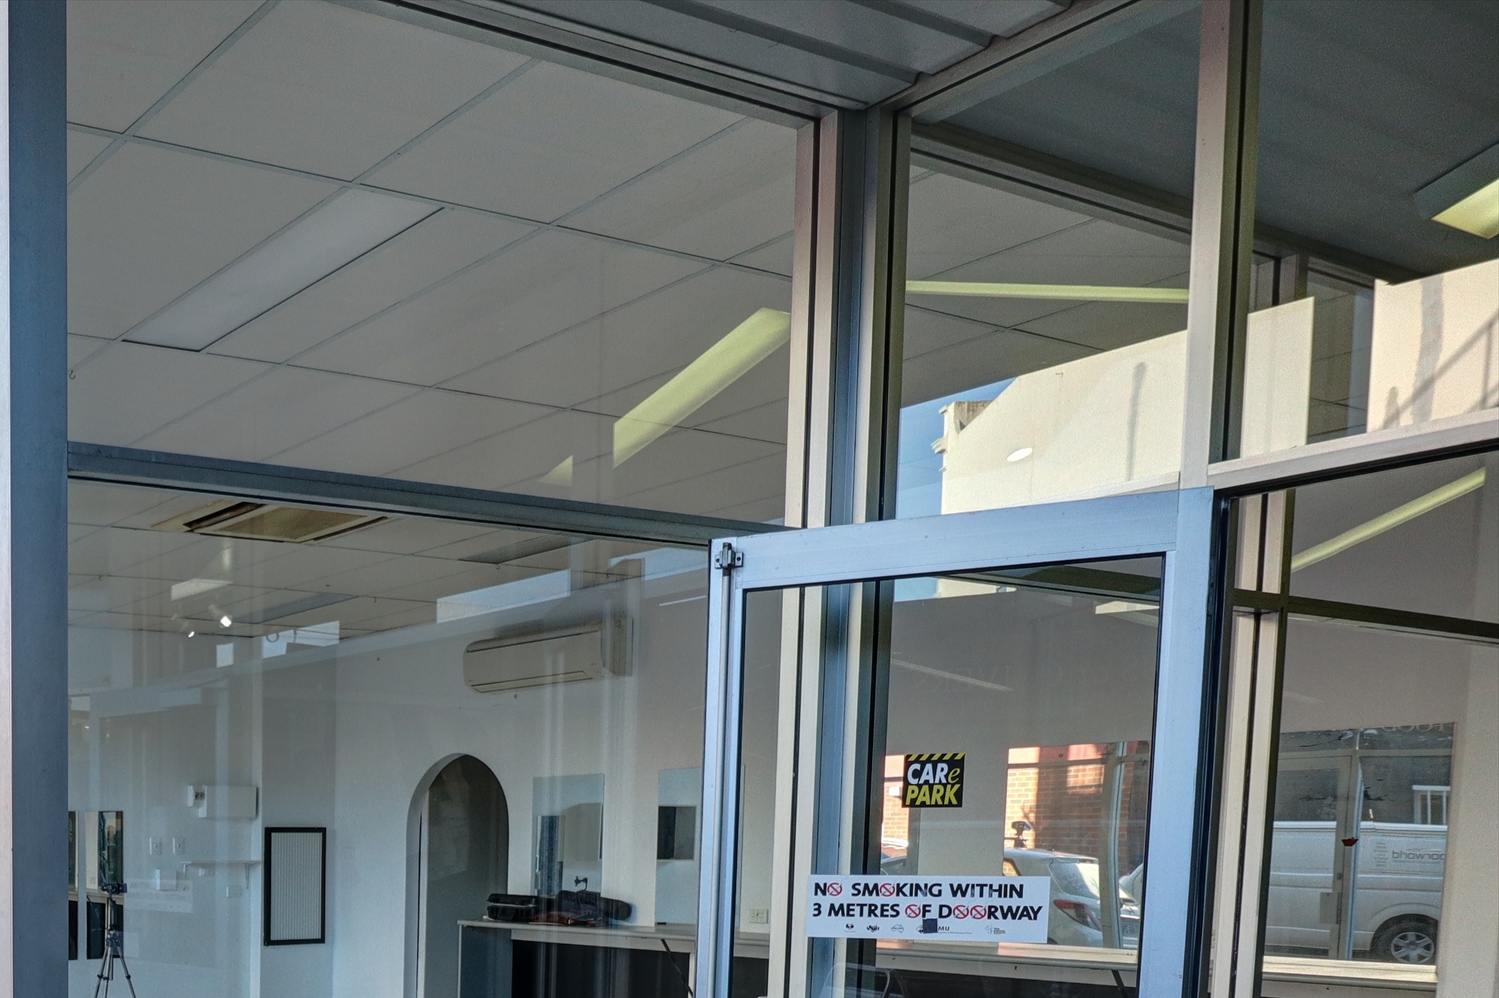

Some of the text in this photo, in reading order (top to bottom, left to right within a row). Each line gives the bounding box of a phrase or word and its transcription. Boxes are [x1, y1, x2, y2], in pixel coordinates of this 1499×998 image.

[905, 784, 961, 805] PARK
[814, 881, 1024, 898] NO SMOKING WITHIN
[812, 903, 1043, 921] 3 METRES OF DOORWAY
